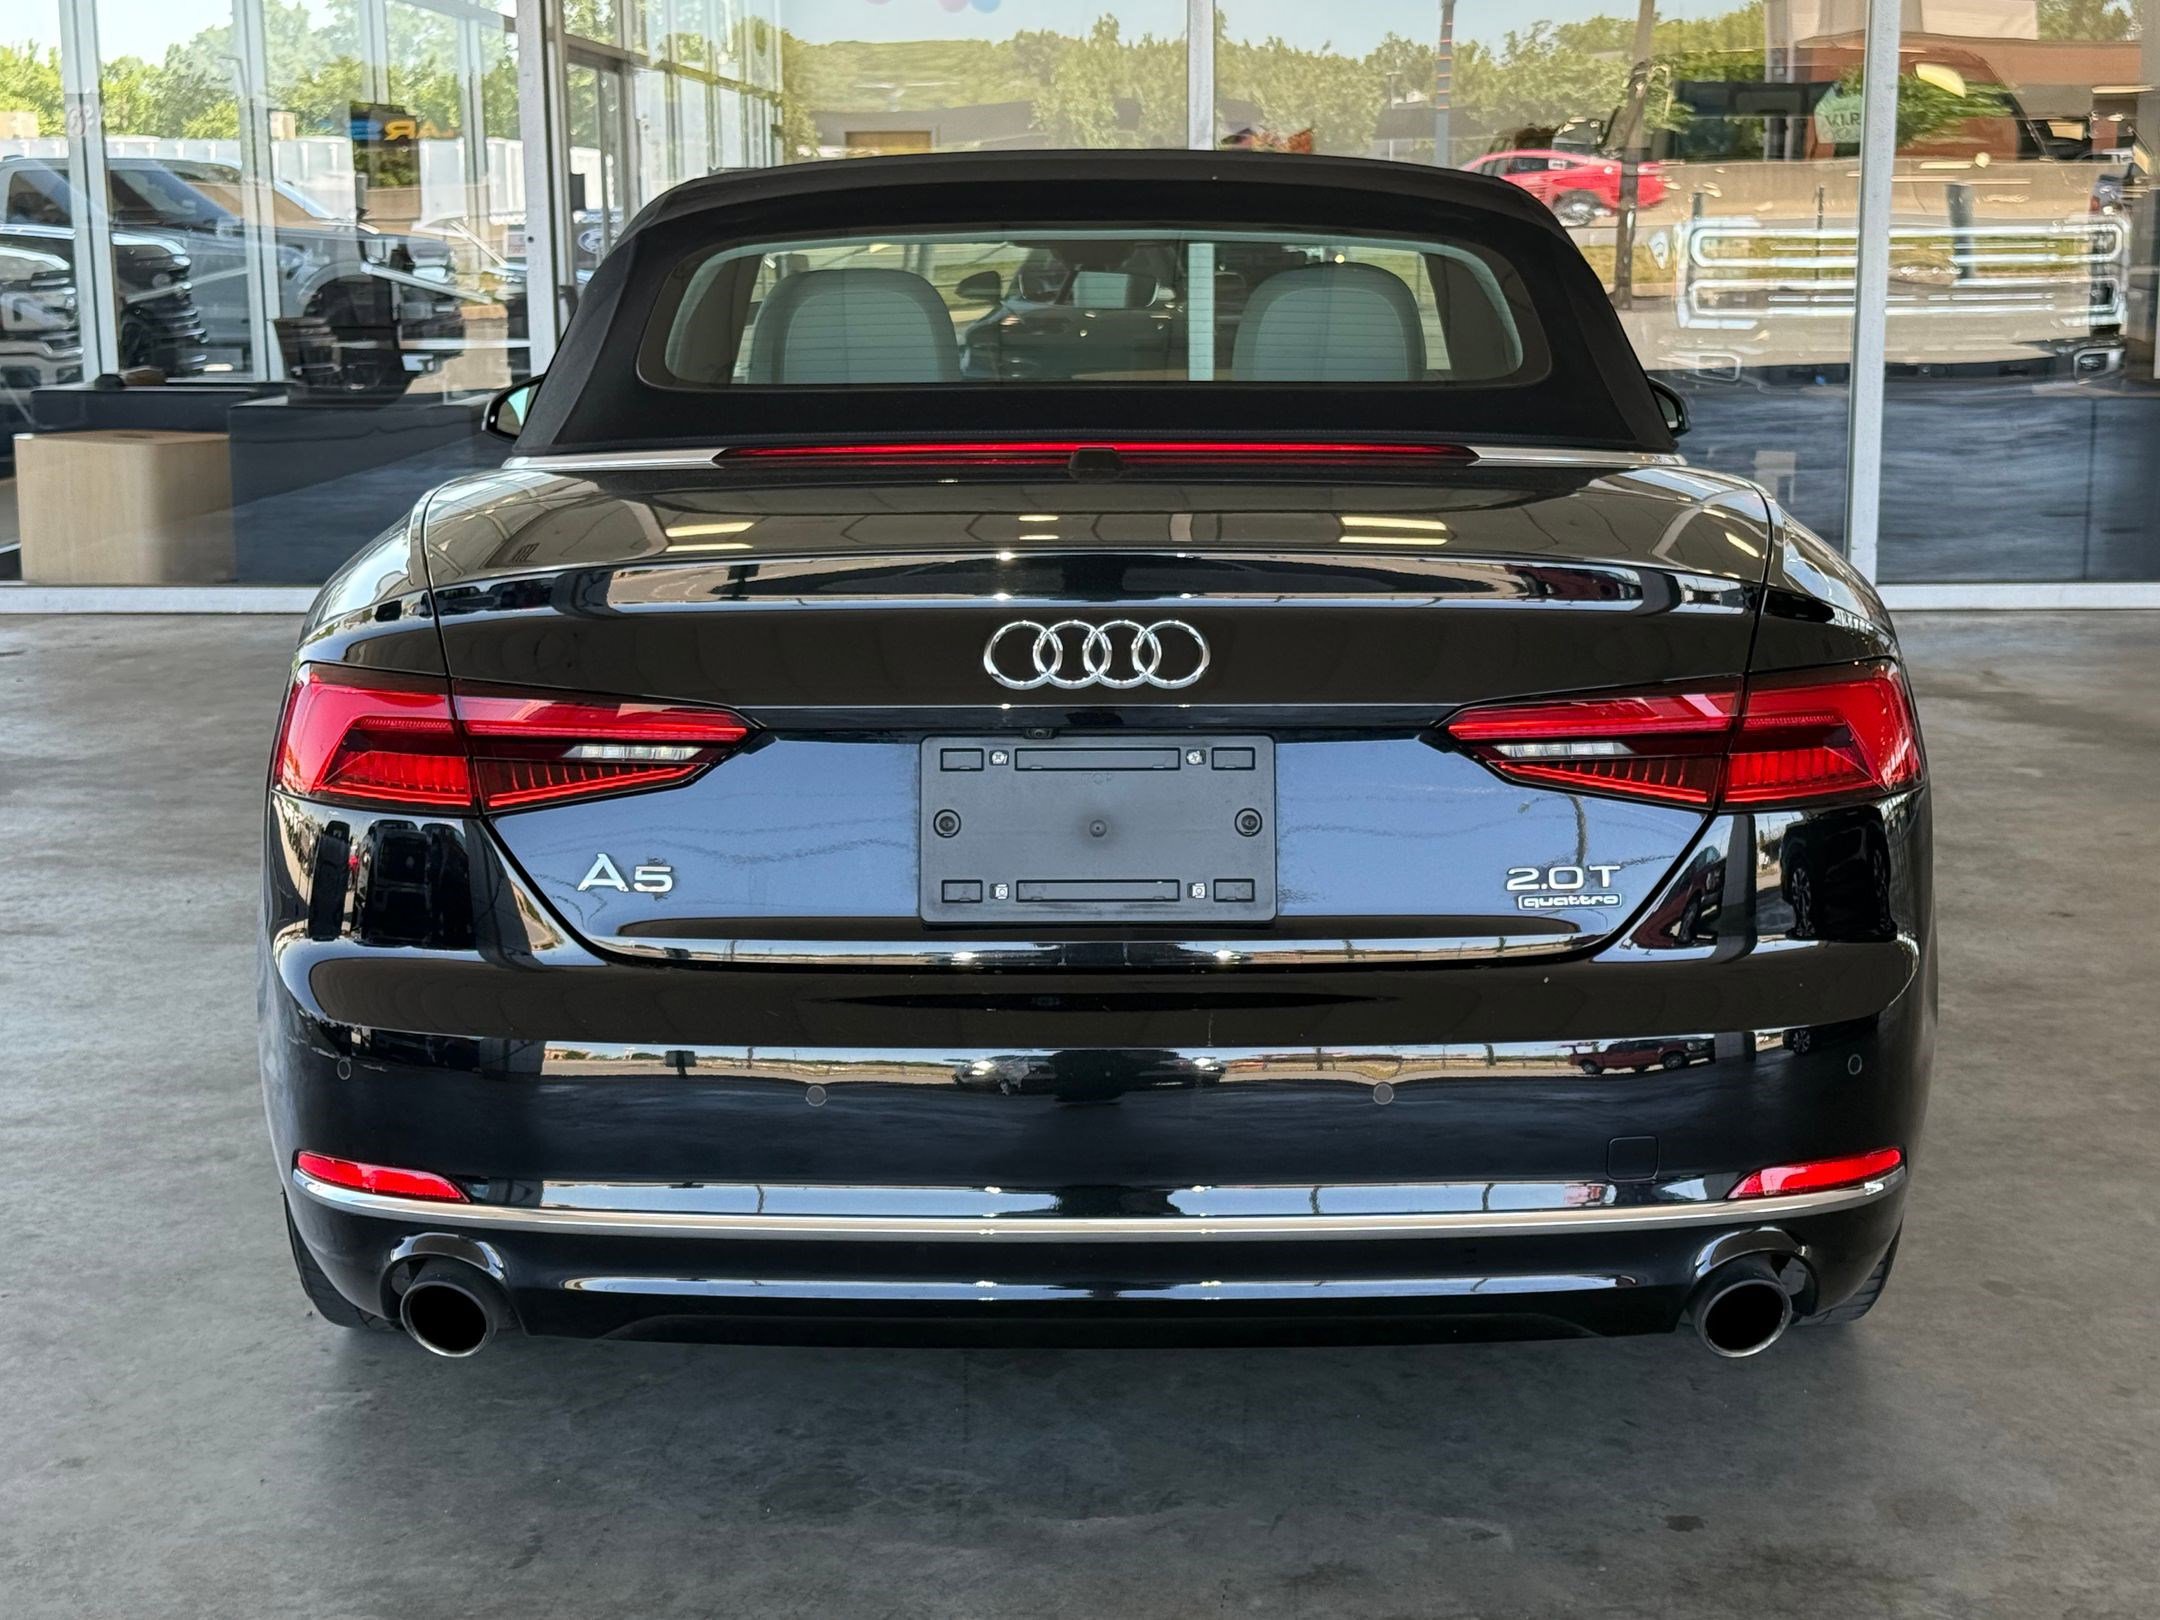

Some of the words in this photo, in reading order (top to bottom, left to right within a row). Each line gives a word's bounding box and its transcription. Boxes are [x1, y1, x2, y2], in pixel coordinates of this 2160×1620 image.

[577, 853, 673, 892] A5
[1506, 865, 1621, 891] 2.0T
[1523, 894, 1619, 909] quattro
